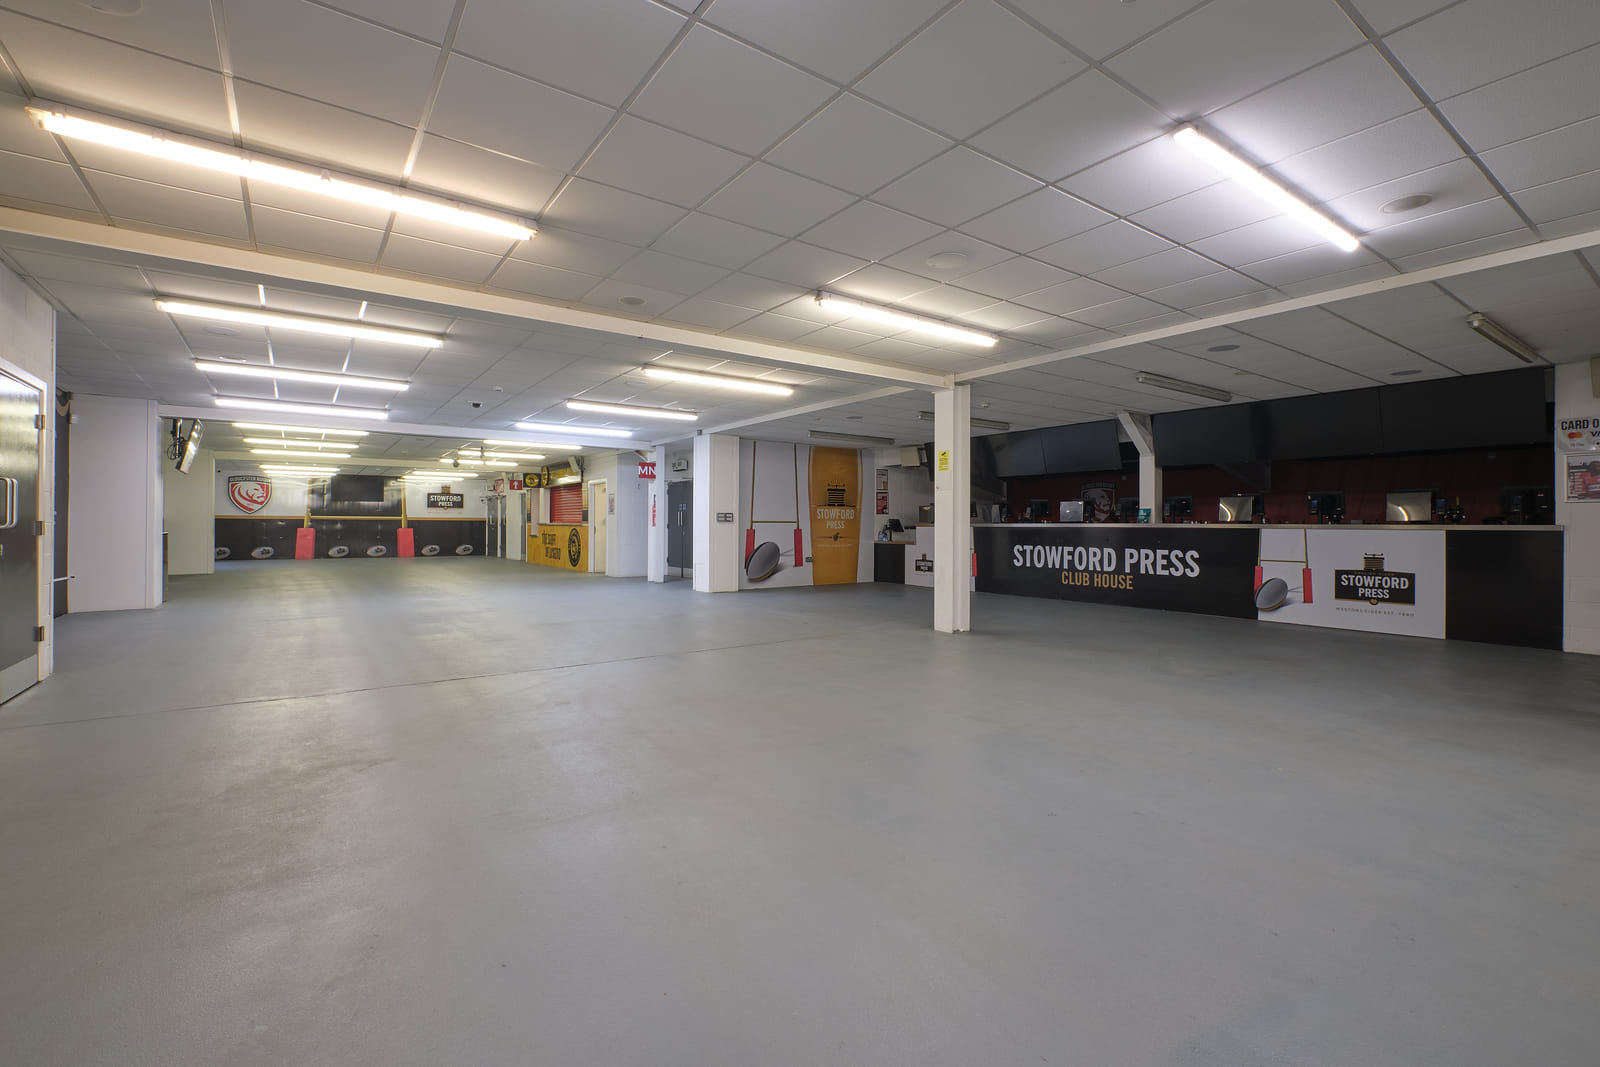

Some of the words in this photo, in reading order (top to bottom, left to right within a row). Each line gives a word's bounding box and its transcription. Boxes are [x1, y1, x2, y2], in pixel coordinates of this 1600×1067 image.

[1560, 419, 1589, 431] CARD
[816, 508, 855, 520] STOWFORD
[826, 520, 845, 529] PRESS
[1013, 544, 1117, 572] STOWFORD
[1124, 548, 1200, 577] PRESS
[1061, 571, 1090, 586] CLUB
[1093, 573, 1134, 590] HOUSE
[1340, 574, 1409, 589] STOWFORD
[1358, 587, 1390, 599] PRESS
